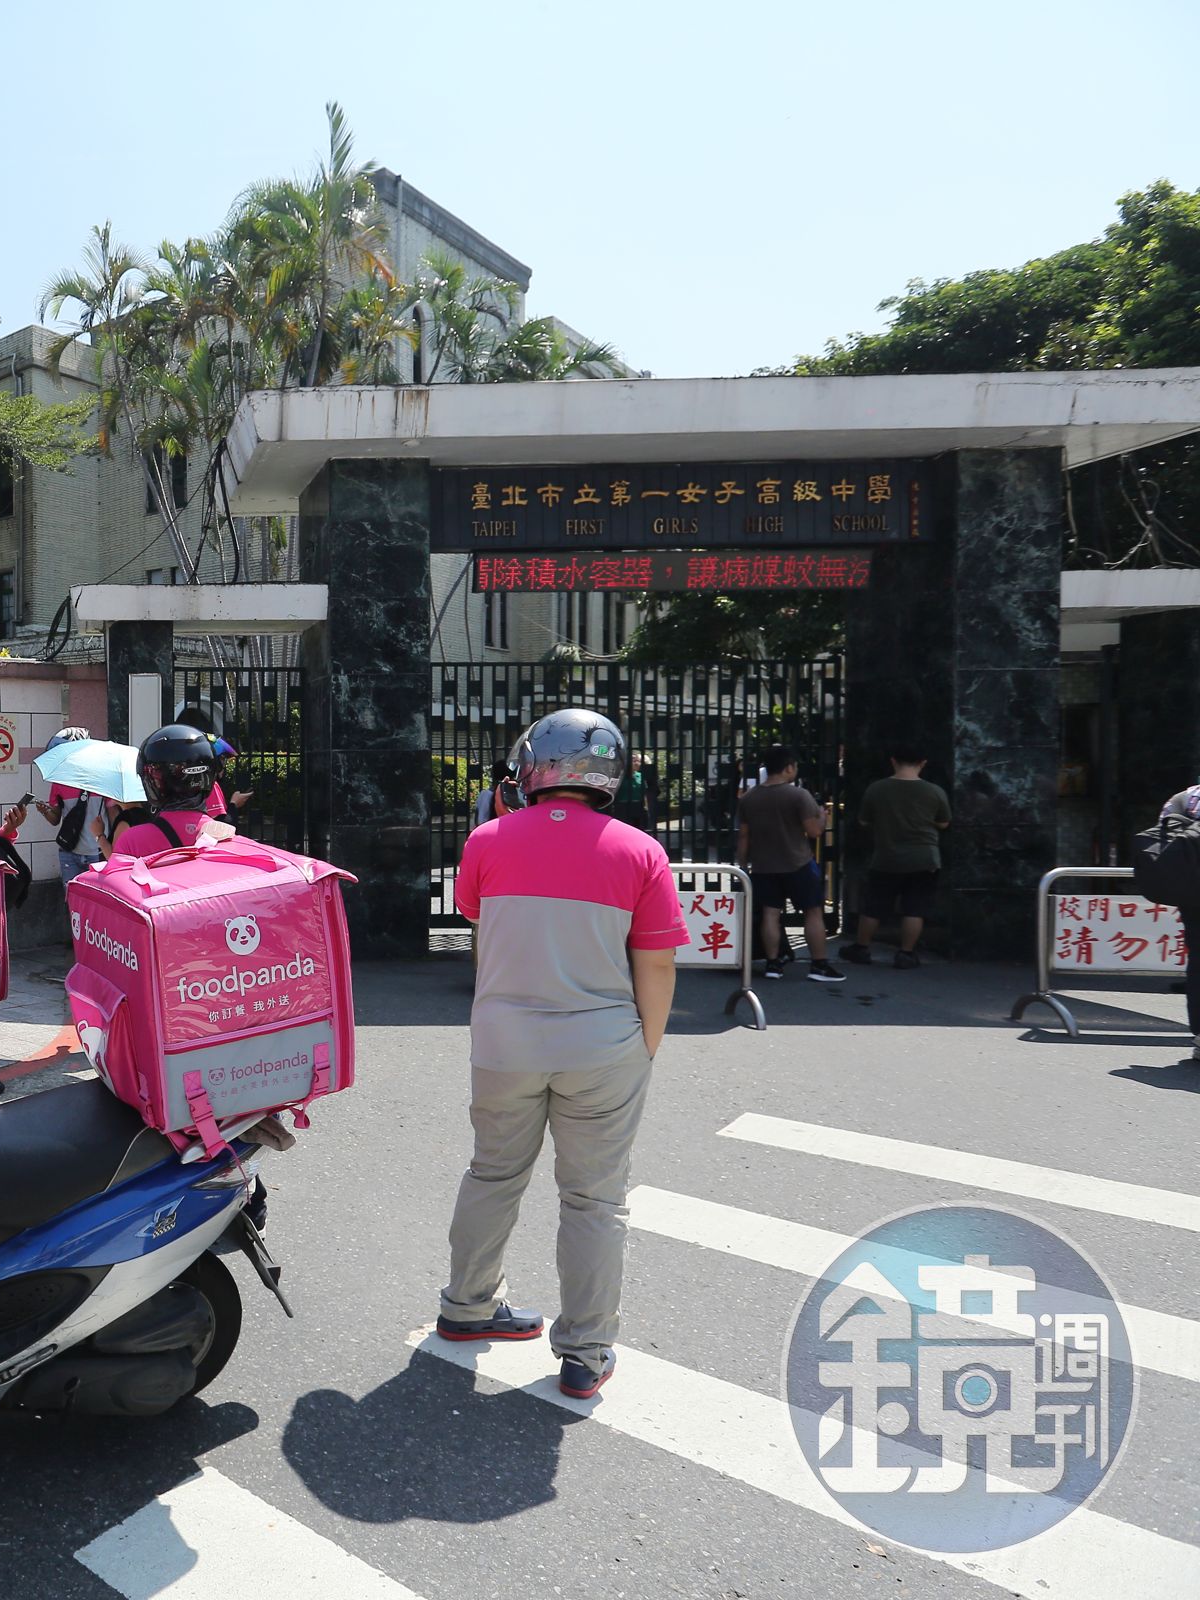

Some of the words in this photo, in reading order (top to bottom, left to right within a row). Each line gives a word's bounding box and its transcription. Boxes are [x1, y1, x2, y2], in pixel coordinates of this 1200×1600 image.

[471, 475, 892, 510] 臺北市立第一女子高級中學
[472, 520, 517, 537] TAIPEI
[565, 519, 606, 535] FIRST
[653, 518, 698, 534] GIRLS
[744, 516, 784, 533] HIGH
[832, 515, 890, 532] SCHOOL
[680, 894, 735, 917] 尺內
[85, 919, 138, 971] foodpanda
[698, 921, 734, 960] 車
[1056, 927, 1190, 965] 請勿停
[177, 952, 315, 1003] foodpanda
[253, 994, 290, 1012] 我外送
[230, 1051, 308, 1081] foodpanda
